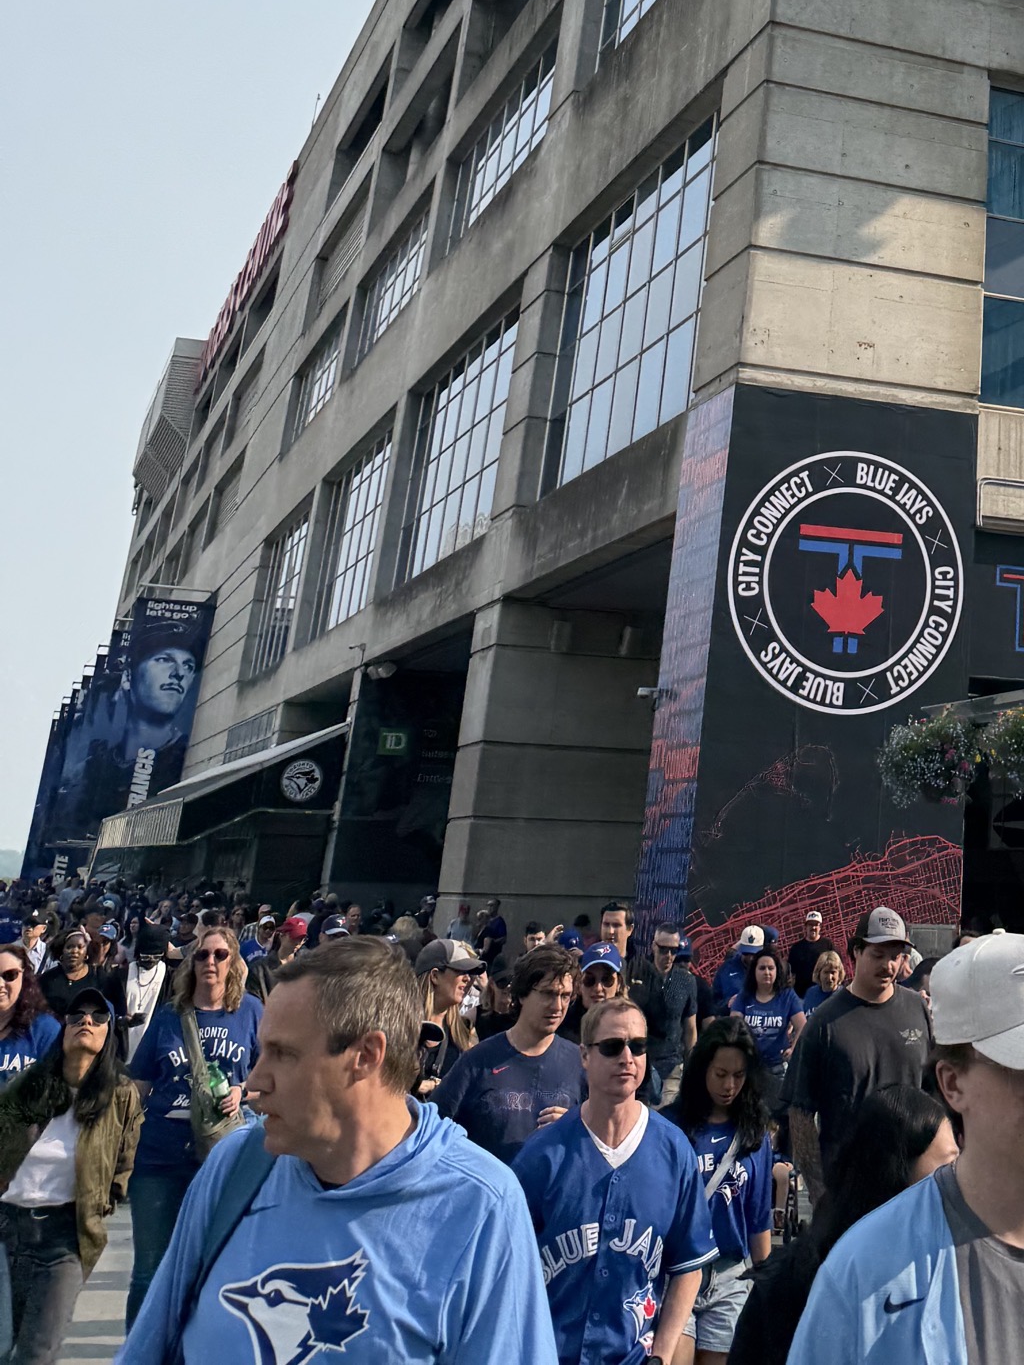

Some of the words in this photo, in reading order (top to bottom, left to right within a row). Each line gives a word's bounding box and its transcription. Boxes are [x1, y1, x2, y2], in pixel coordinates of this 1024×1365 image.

[856, 462, 899, 495] BLUE
[895, 482, 934, 525] JAYS
[746, 470, 814, 546] CONNECT
[738, 547, 762, 597] CITY
[933, 565, 955, 614] CITY
[145, 608, 172, 617] let's
[172, 611, 189, 620] go
[147, 600, 181, 611] lights
[181, 605, 198, 613] up
[760, 641, 804, 679] JAYS
[885, 615, 949, 695] CONNECT
[798, 672, 845, 706] BLUE
[383, 732, 407, 750] TD
[199, 1026, 229, 1039] RONTO
[762, 1016, 782, 1027] JAYS
[0, 1053, 37, 1072] JAY
[210, 1039, 245, 1062] JAYS
